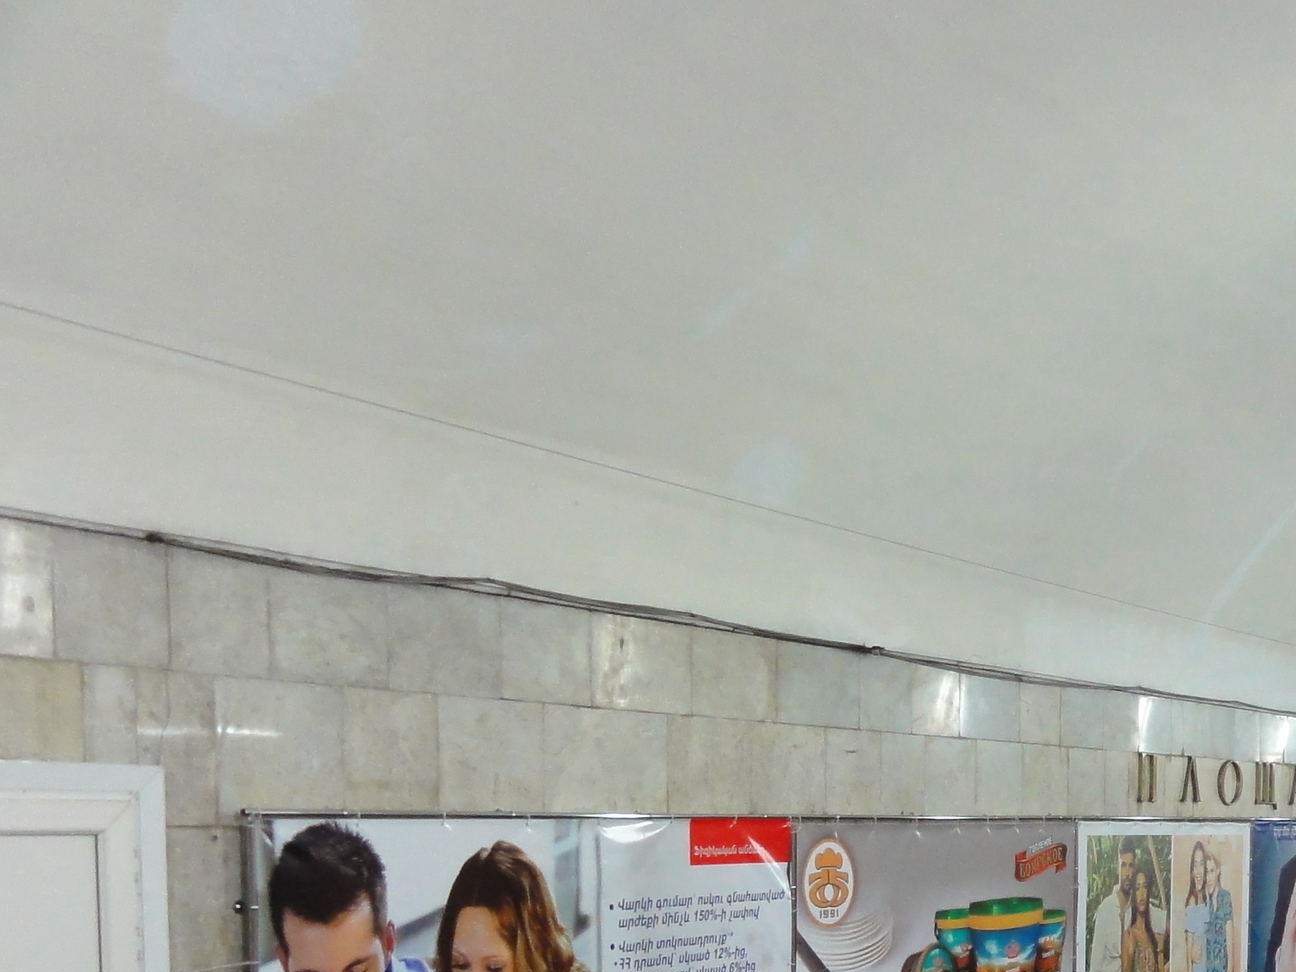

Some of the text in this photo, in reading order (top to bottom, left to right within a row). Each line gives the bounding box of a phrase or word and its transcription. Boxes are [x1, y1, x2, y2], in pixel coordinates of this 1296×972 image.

[618, 897, 653, 913] Վարկի
[819, 909, 839, 919] 1991
[619, 939, 653, 954] Վարկի
